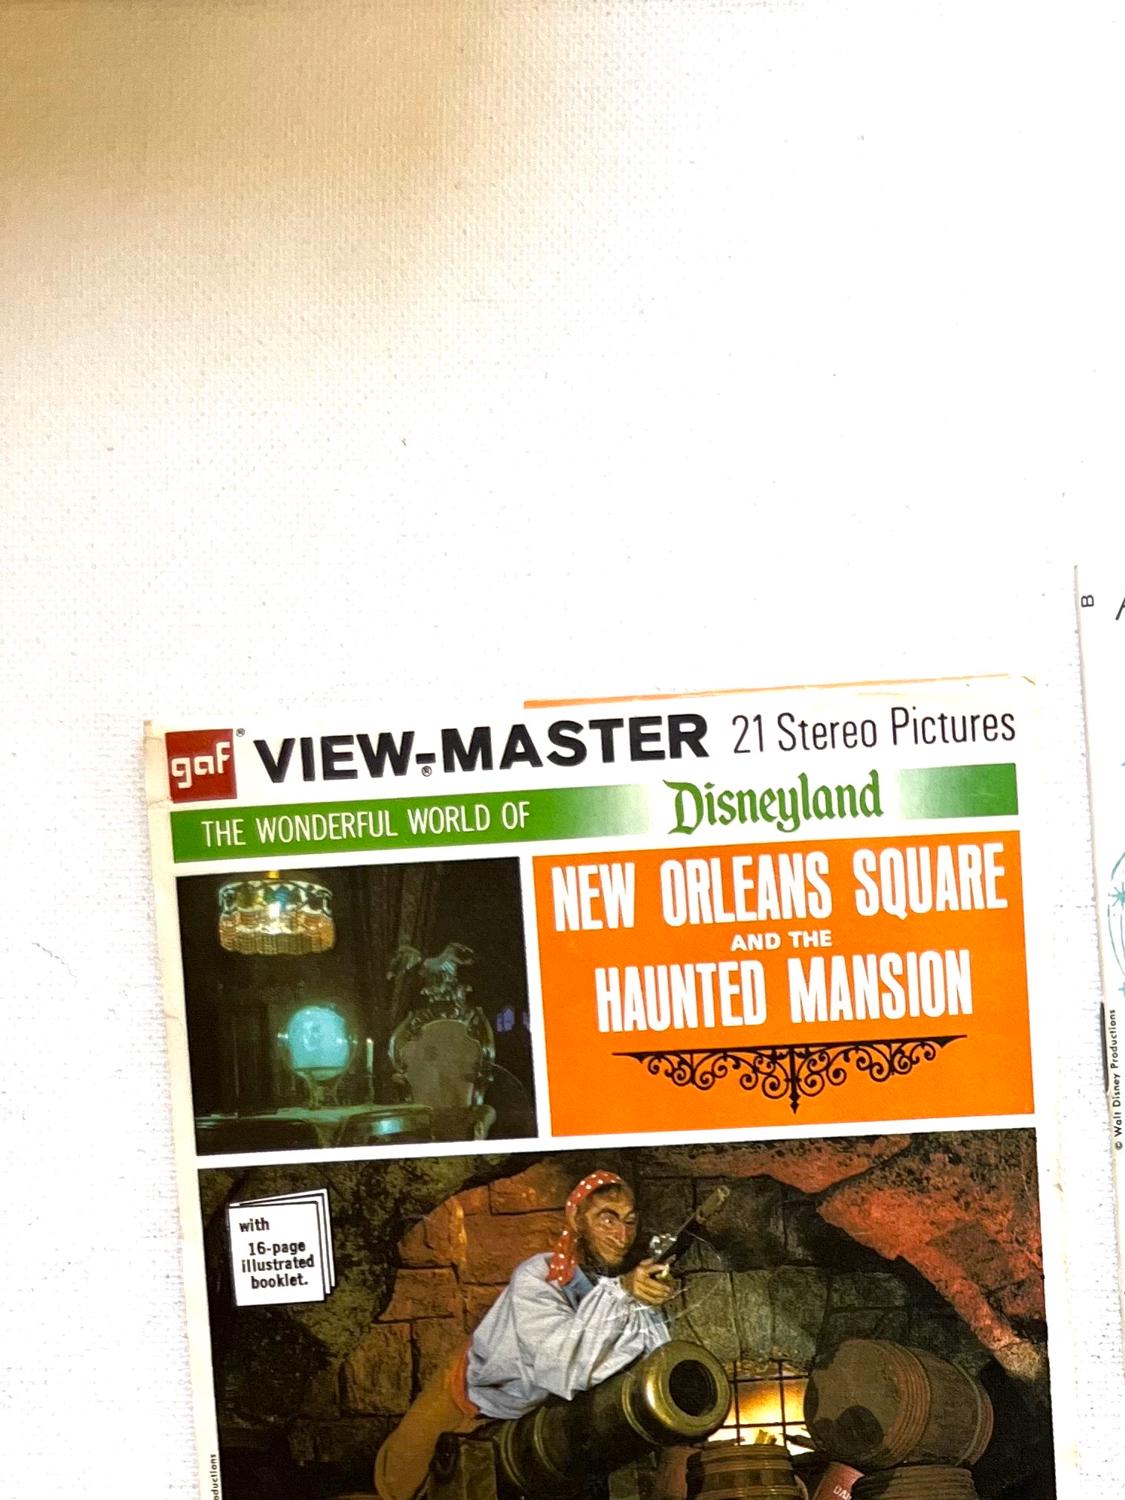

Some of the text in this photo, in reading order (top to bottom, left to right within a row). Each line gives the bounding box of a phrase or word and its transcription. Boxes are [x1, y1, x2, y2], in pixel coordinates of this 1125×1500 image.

[1081, 595, 1094, 607] B
[171, 741, 231, 789] gaf
[732, 714, 764, 754] 21
[778, 712, 877, 752] Stereo
[891, 706, 1016, 746] Pictures
[201, 769, 884, 848] THE WONDERFUL WORLD OF Disneyland
[551, 842, 1008, 932] NEW ORLEANS SQUARE
[731, 929, 832, 951] AND THE
[594, 949, 973, 1033] HAUNTED MANSION
[1109, 1009, 1122, 1137] Walt Disney Productions
[239, 1218, 269, 1233] with
[248, 1241, 306, 1259] 16-page
[241, 1255, 315, 1273] illustrated
[251, 1272, 309, 1289] booklet.
